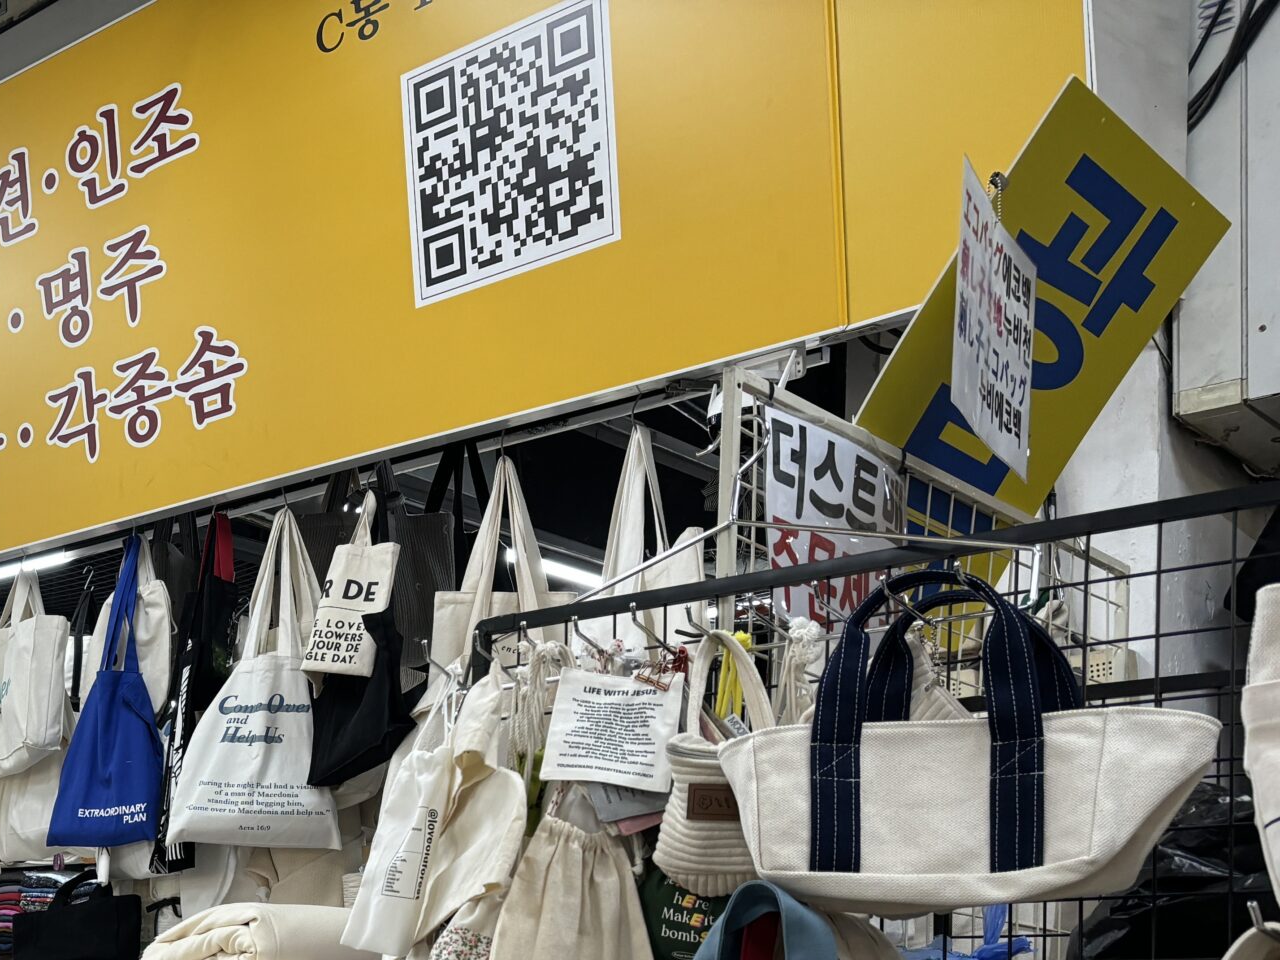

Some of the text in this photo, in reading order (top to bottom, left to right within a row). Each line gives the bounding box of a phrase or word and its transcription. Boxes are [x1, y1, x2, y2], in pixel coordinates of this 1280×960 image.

[342, 579, 380, 602] DE
[312, 629, 364, 642] FLOWERS
[583, 686, 658, 697] LIFE WITH JESUS
[218, 695, 262, 716] Come
[226, 715, 248, 725] and
[219, 726, 285, 747] Help Us
[78, 803, 147, 819] EXTRAORDINARY
[123, 813, 147, 824] PLAN
